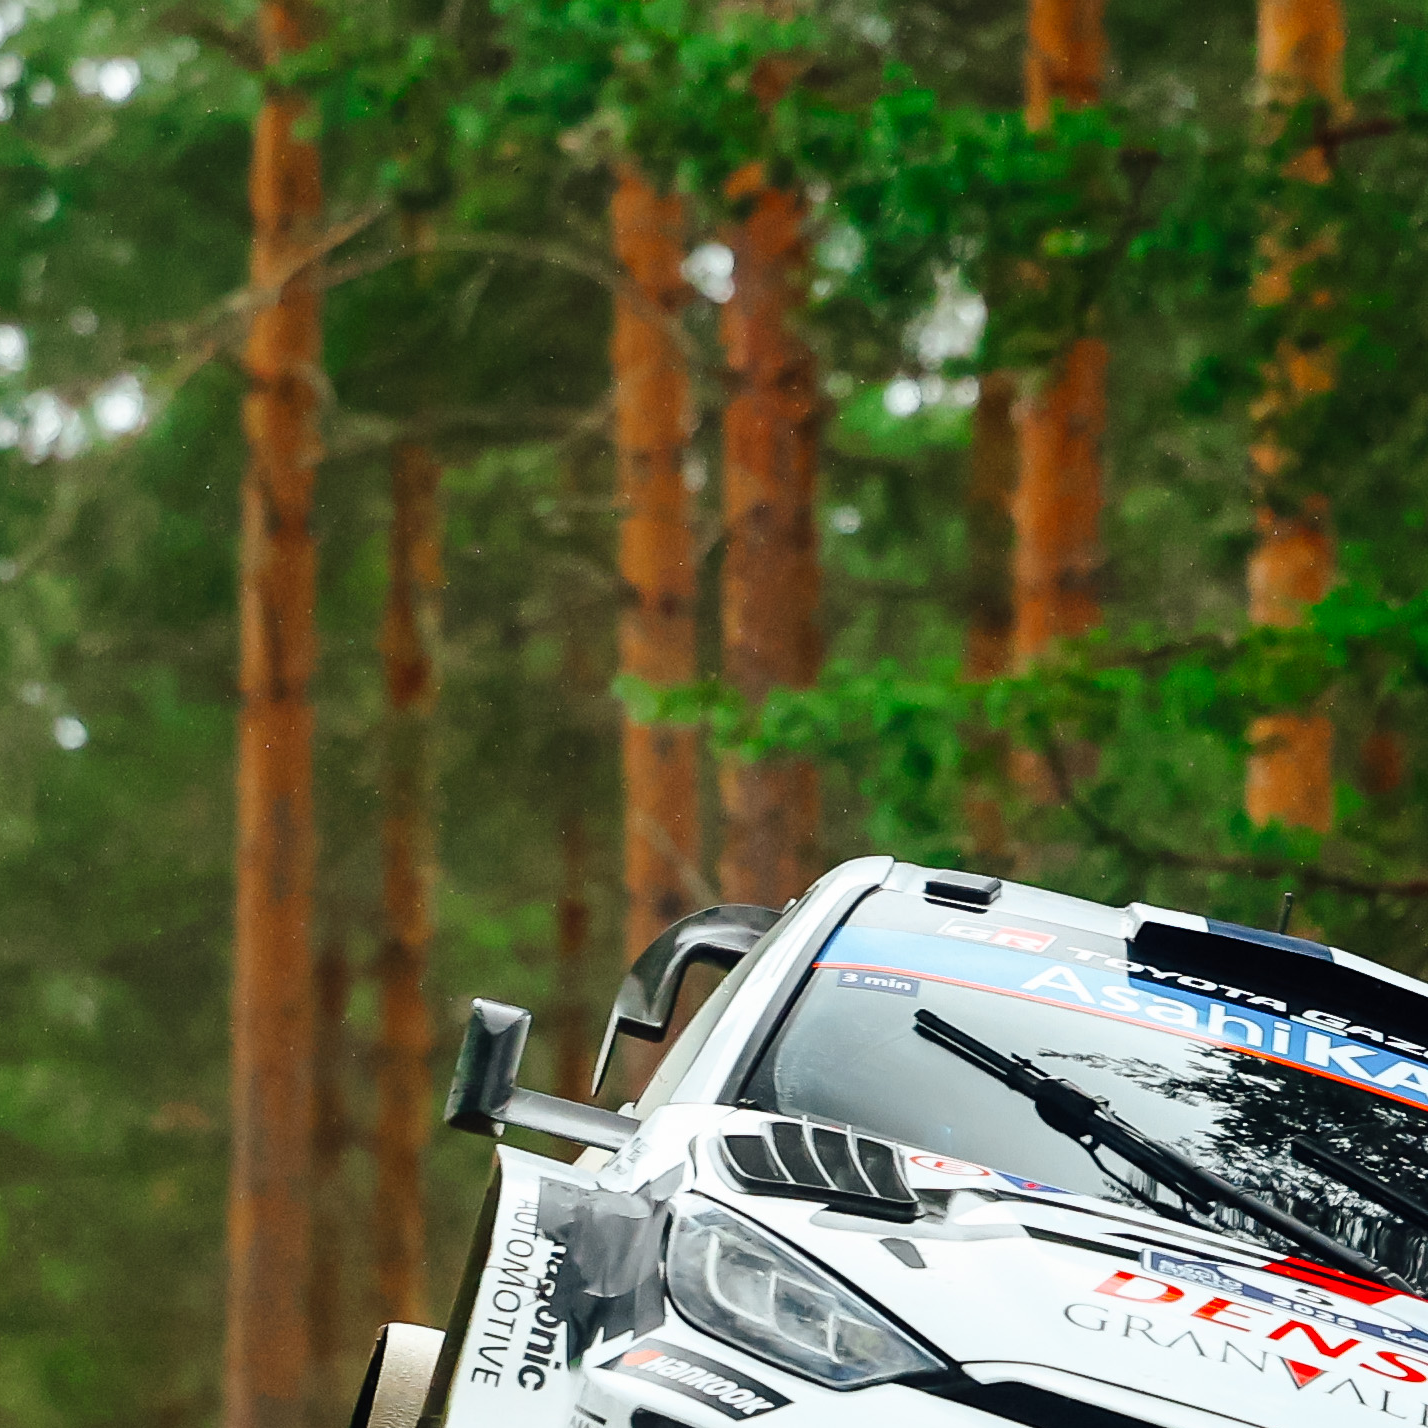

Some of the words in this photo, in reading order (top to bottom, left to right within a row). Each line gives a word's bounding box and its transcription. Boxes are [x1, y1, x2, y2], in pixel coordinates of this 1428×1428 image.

[841, 972, 859, 983] 3
[864, 977, 912, 991] min
[942, 922, 1047, 951] GR
[1067, 947, 1288, 1013] TOYOTA
[1271, 1296, 1359, 1329] 2025
